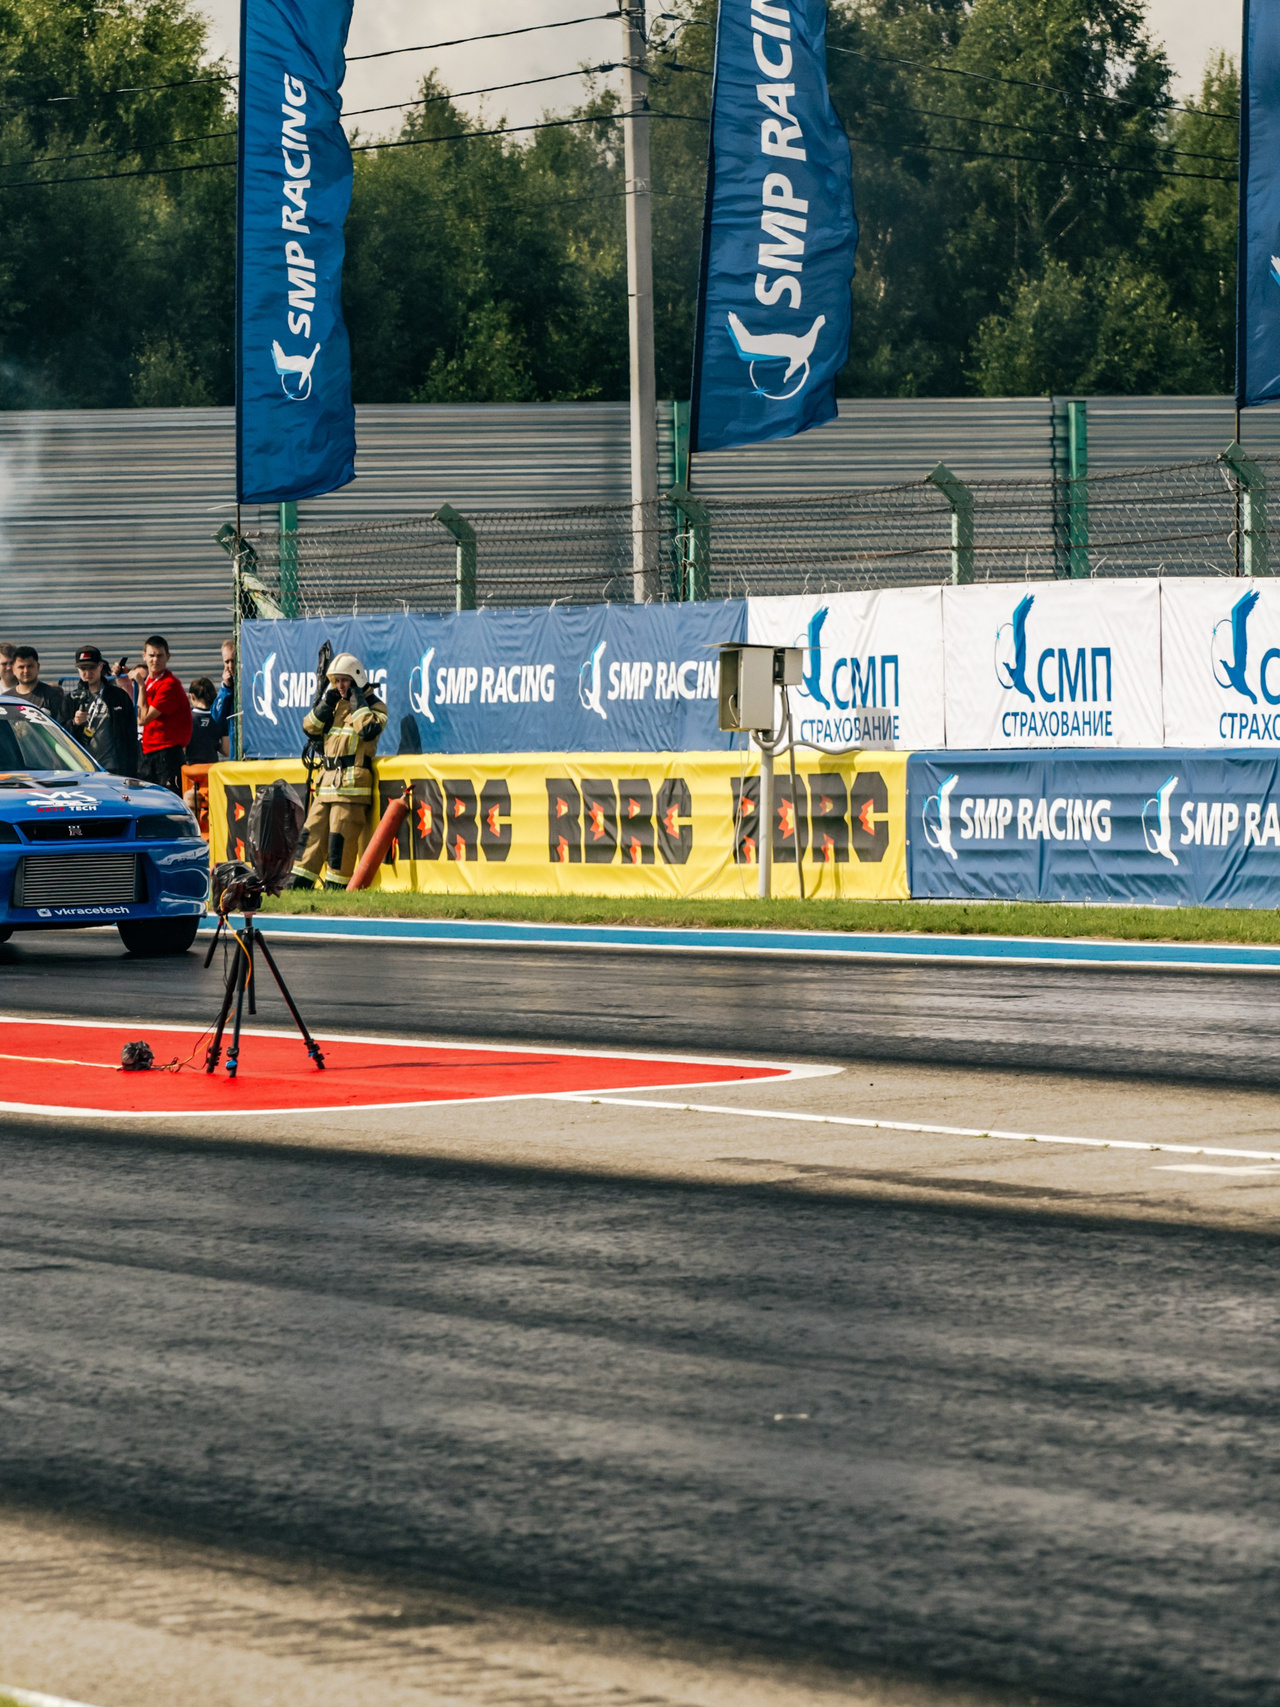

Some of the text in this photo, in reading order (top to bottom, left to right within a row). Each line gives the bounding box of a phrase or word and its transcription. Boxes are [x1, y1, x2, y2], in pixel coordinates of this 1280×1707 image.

[281, 72, 317, 339] SMP RACING
[754, 174, 809, 310] SMP
[278, 672, 317, 707] SMP
[435, 664, 554, 704] SMP RACING
[607, 660, 719, 700] SMP RACIN
[831, 654, 899, 710] СМП
[1038, 647, 1112, 702] СМП
[800, 715, 899, 744] СТРАХОВАНИЕ
[1002, 710, 1113, 738] СТРАХОВАНИЕ
[546, 777, 693, 865] RDRC
[730, 771, 889, 865] RDRC
[960, 797, 1112, 843] SMP RACING
[1180, 801, 1240, 845] SMP
[54, 906, 130, 915] vkracetech
